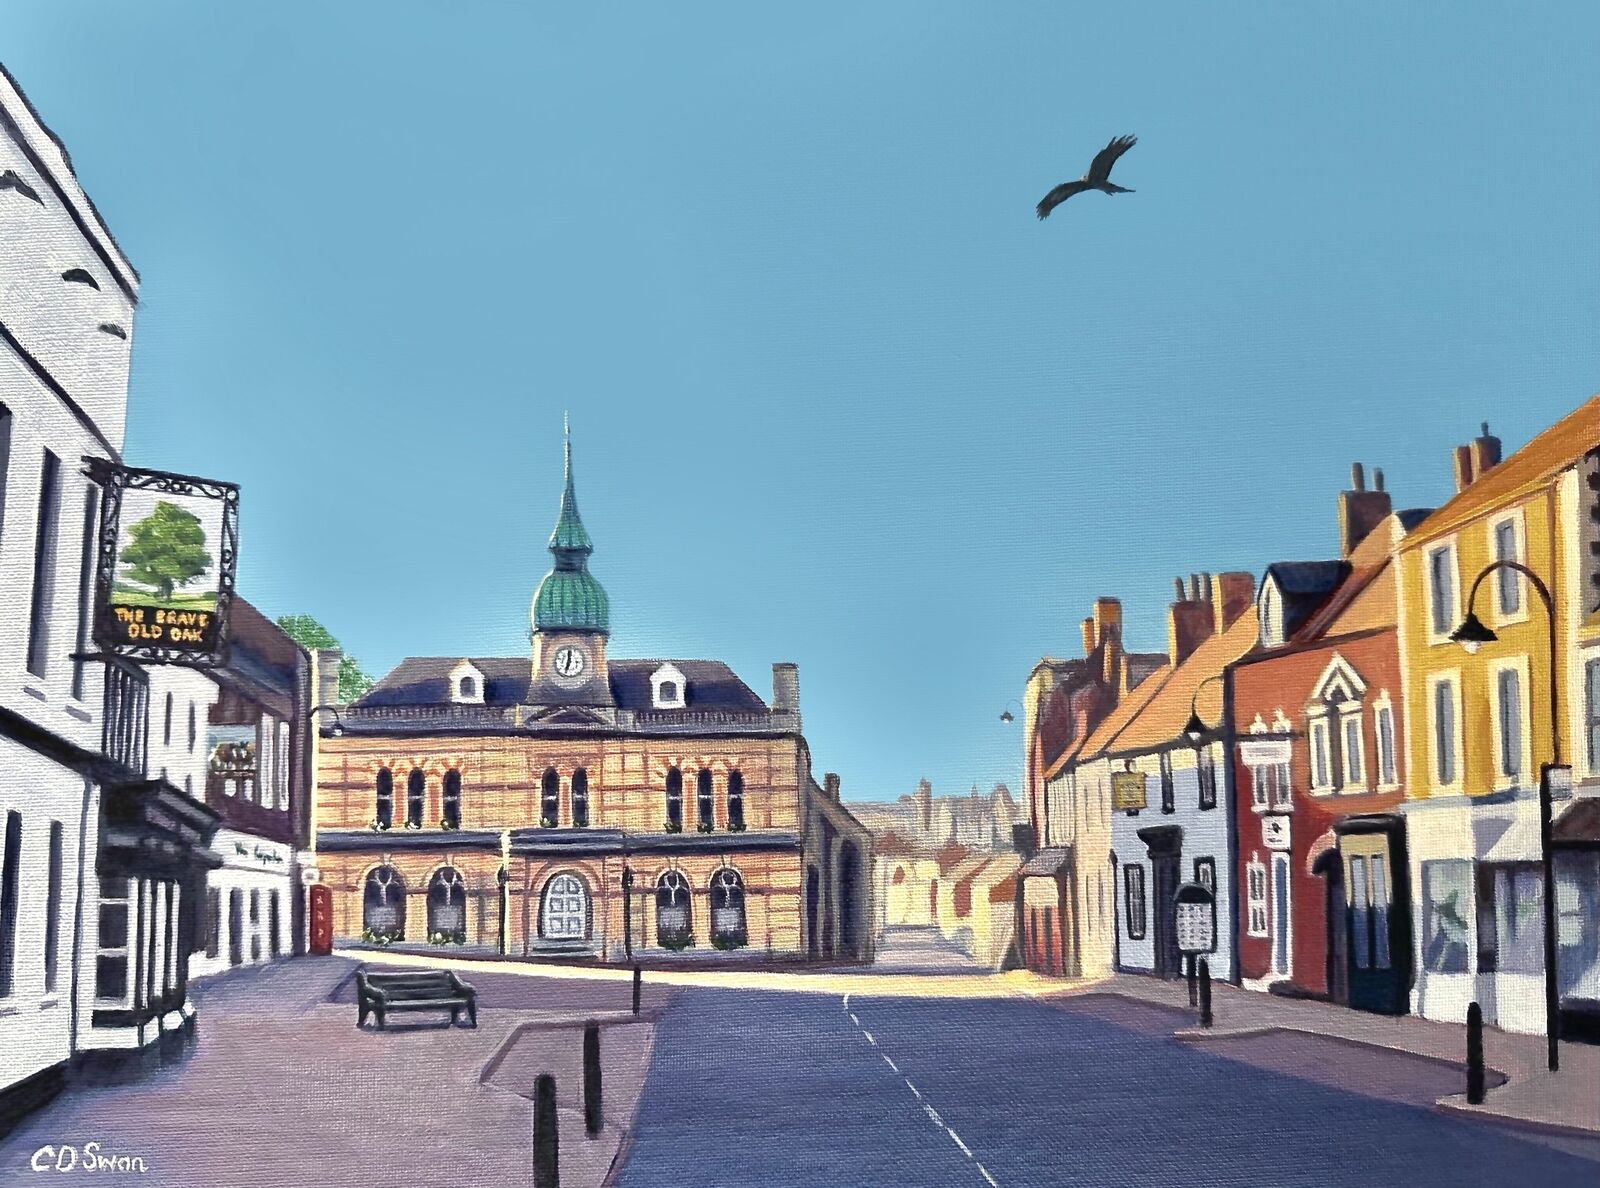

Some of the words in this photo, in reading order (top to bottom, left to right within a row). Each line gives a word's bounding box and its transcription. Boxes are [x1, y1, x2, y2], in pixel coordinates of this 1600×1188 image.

[114, 607, 144, 623] THE
[156, 609, 209, 627] BRAVE
[128, 623, 162, 639] OLD
[170, 626, 203, 642] OAK
[82, 1142, 149, 1172] Swan
